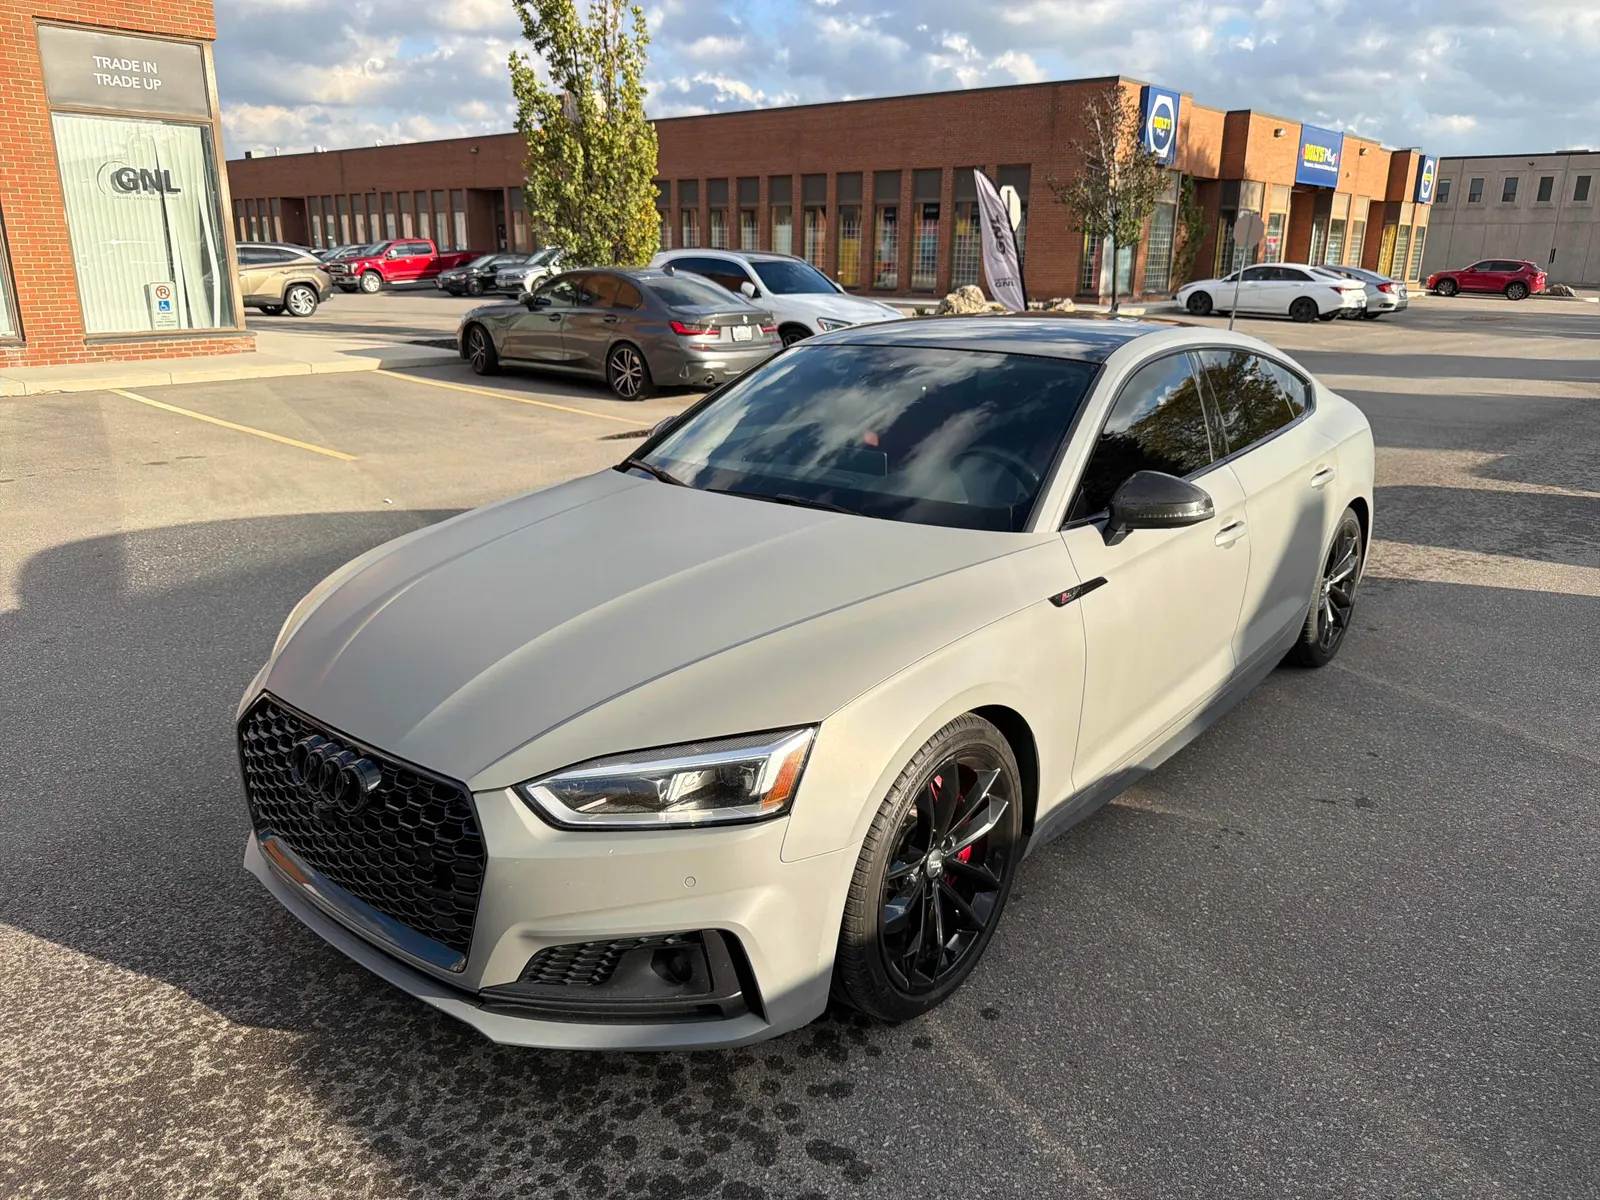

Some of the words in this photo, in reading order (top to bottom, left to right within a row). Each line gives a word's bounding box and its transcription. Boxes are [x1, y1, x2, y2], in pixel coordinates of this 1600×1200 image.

[93, 55, 141, 72] TRADE
[142, 61, 158, 74] IN
[93, 72, 141, 89] TRADE
[142, 77, 162, 91] UP
[1153, 115, 1172, 130] BOLTS
[1304, 143, 1325, 163] BOLTS
[115, 167, 182, 193] GNL
